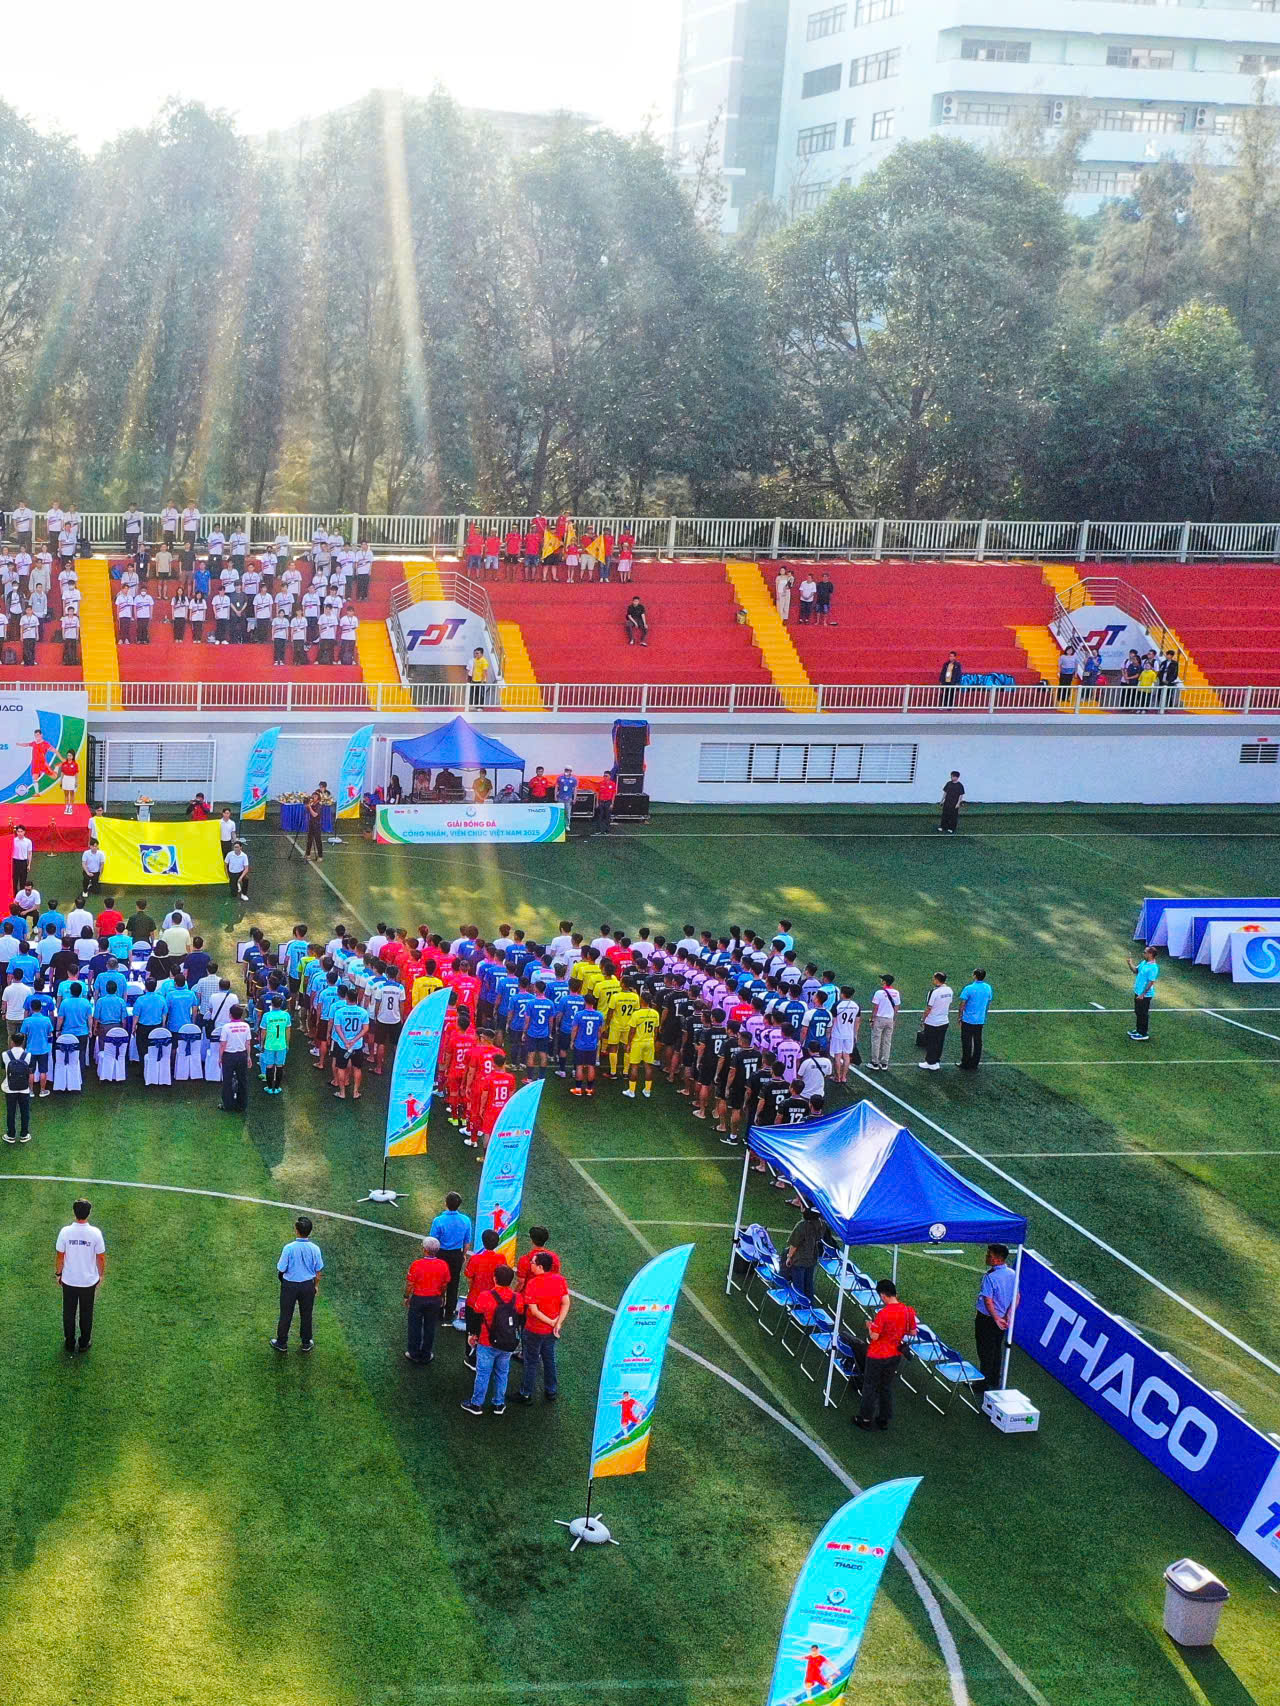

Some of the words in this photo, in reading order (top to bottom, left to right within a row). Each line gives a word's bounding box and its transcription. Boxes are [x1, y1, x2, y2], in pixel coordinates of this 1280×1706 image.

[406, 618, 467, 651] TDT
[447, 820, 462, 828] GIẢI
[464, 820, 485, 828] BÓNG
[486, 820, 496, 828] ĐÁ
[450, 829, 467, 837] VIÊN
[463, 990, 470, 1002] 7
[387, 997, 394, 1010] 8
[538, 1010, 546, 1024] 5
[621, 1004, 634, 1017] 92
[344, 1018, 359, 1032] 20
[791, 1014, 799, 1028] 6
[841, 1013, 854, 1024] 94
[586, 1021, 594, 1035] 8
[644, 1021, 654, 1033] 15
[815, 1022, 827, 1037] 16
[744, 1064, 758, 1079] 11
[494, 1087, 508, 1100] 18
[1039, 1290, 1218, 1472] THACO
[834, 1561, 863, 1571] THACO
